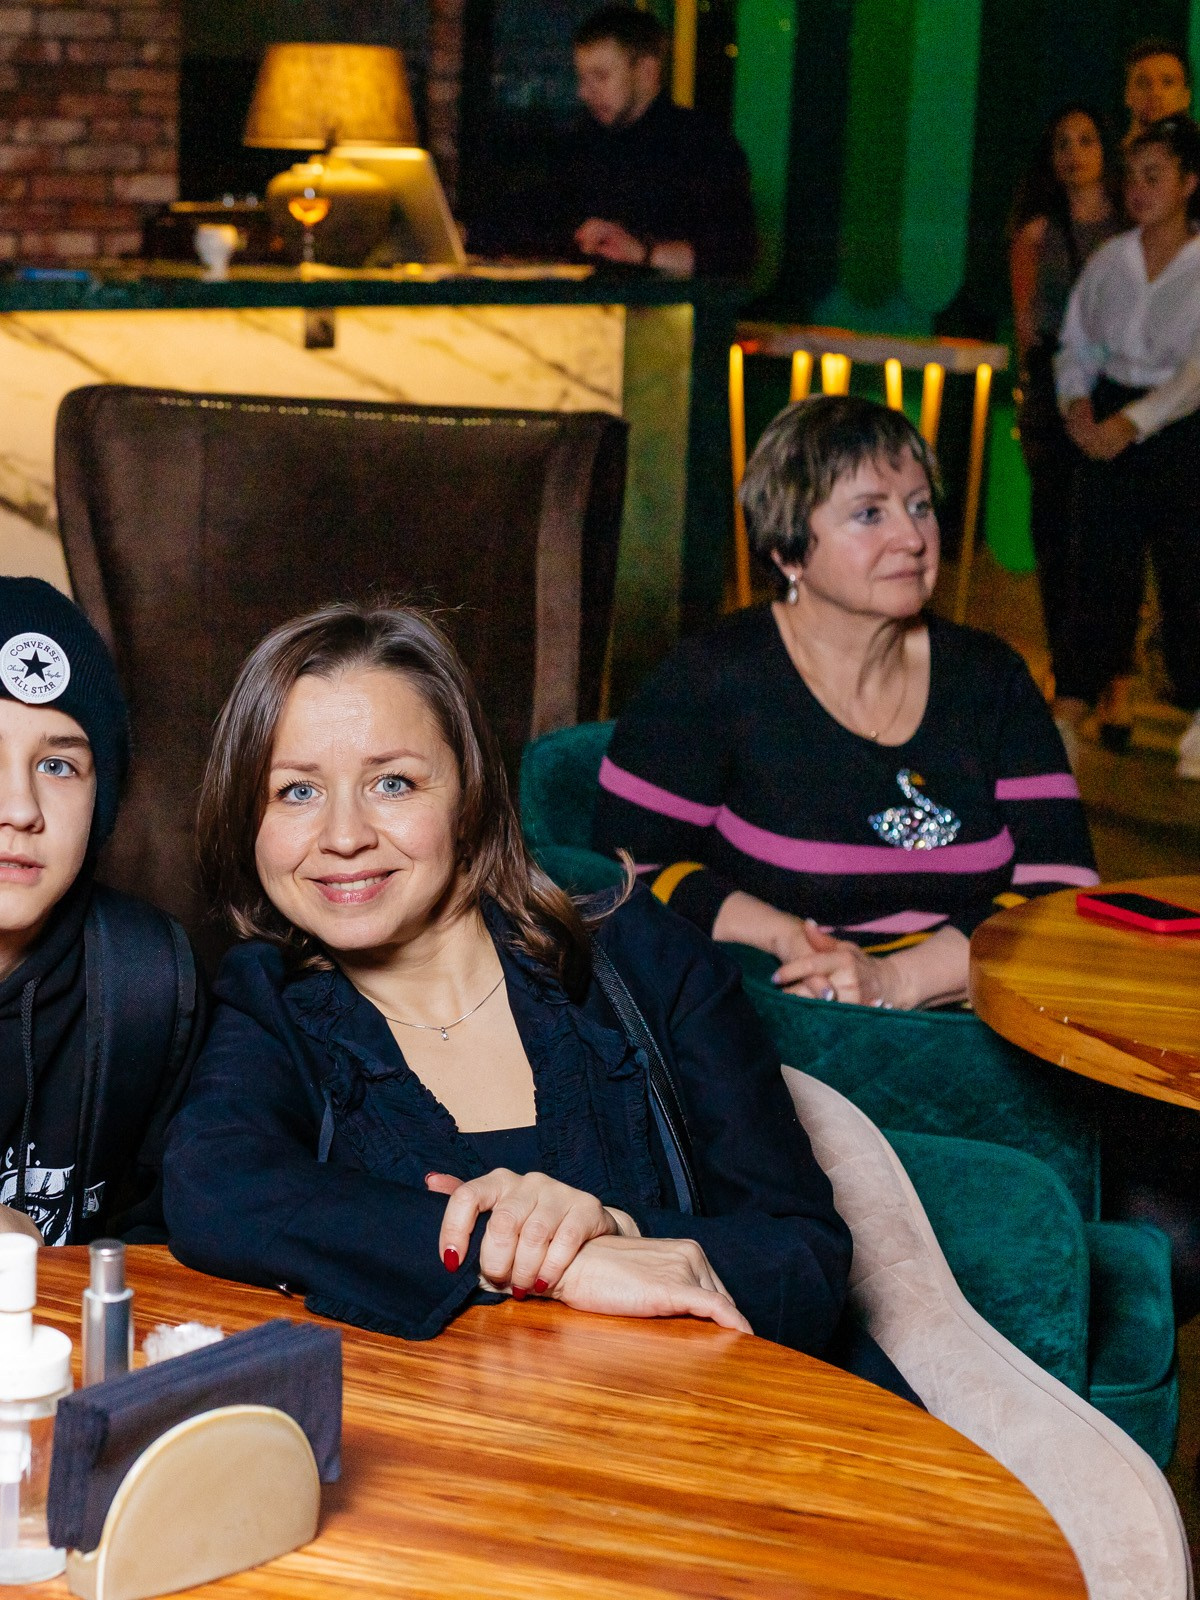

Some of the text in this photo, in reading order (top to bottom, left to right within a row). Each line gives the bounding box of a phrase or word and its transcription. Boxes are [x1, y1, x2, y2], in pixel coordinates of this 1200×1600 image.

[10, 641, 60, 662] CONVERSE
[7, 664, 25, 673] Chuck
[12, 675, 56, 694] ALL STAR
